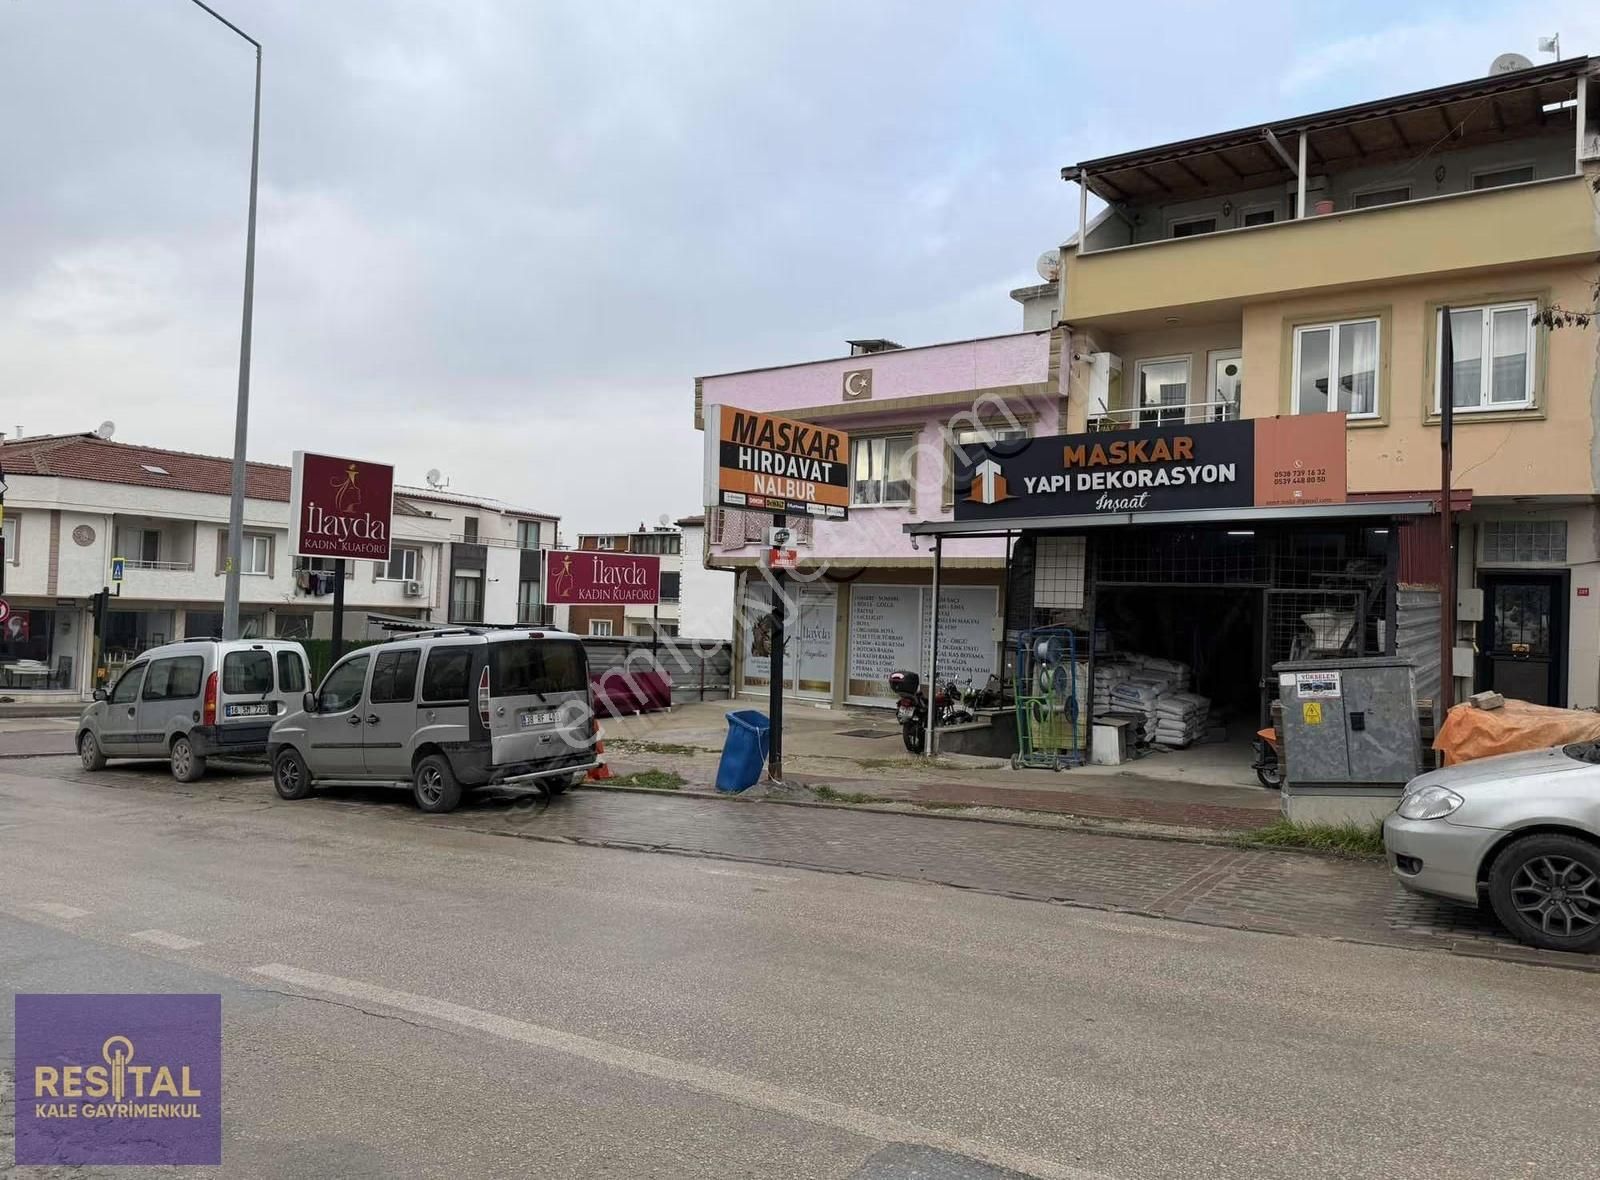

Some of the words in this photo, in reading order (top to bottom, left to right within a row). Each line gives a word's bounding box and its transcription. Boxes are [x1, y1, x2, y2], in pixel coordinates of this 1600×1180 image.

[731, 412, 839, 461] MASKAR
[1063, 436, 1194, 469] MASKAR
[739, 447, 832, 482] HIRDAVAT
[1023, 474, 1072, 495] YAPI
[1077, 463, 1237, 492] DEKORASYON
[754, 475, 816, 501] NALBUR
[1095, 491, 1151, 513] İnşaat
[307, 501, 386, 542] İlayda
[305, 539, 337, 550] KADIN
[341, 542, 386, 554] KUAFÖRÜ
[592, 556, 647, 589] İlayda
[579, 588, 611, 600] KADIN
[613, 587, 656, 601] KUAFÖRÜ
